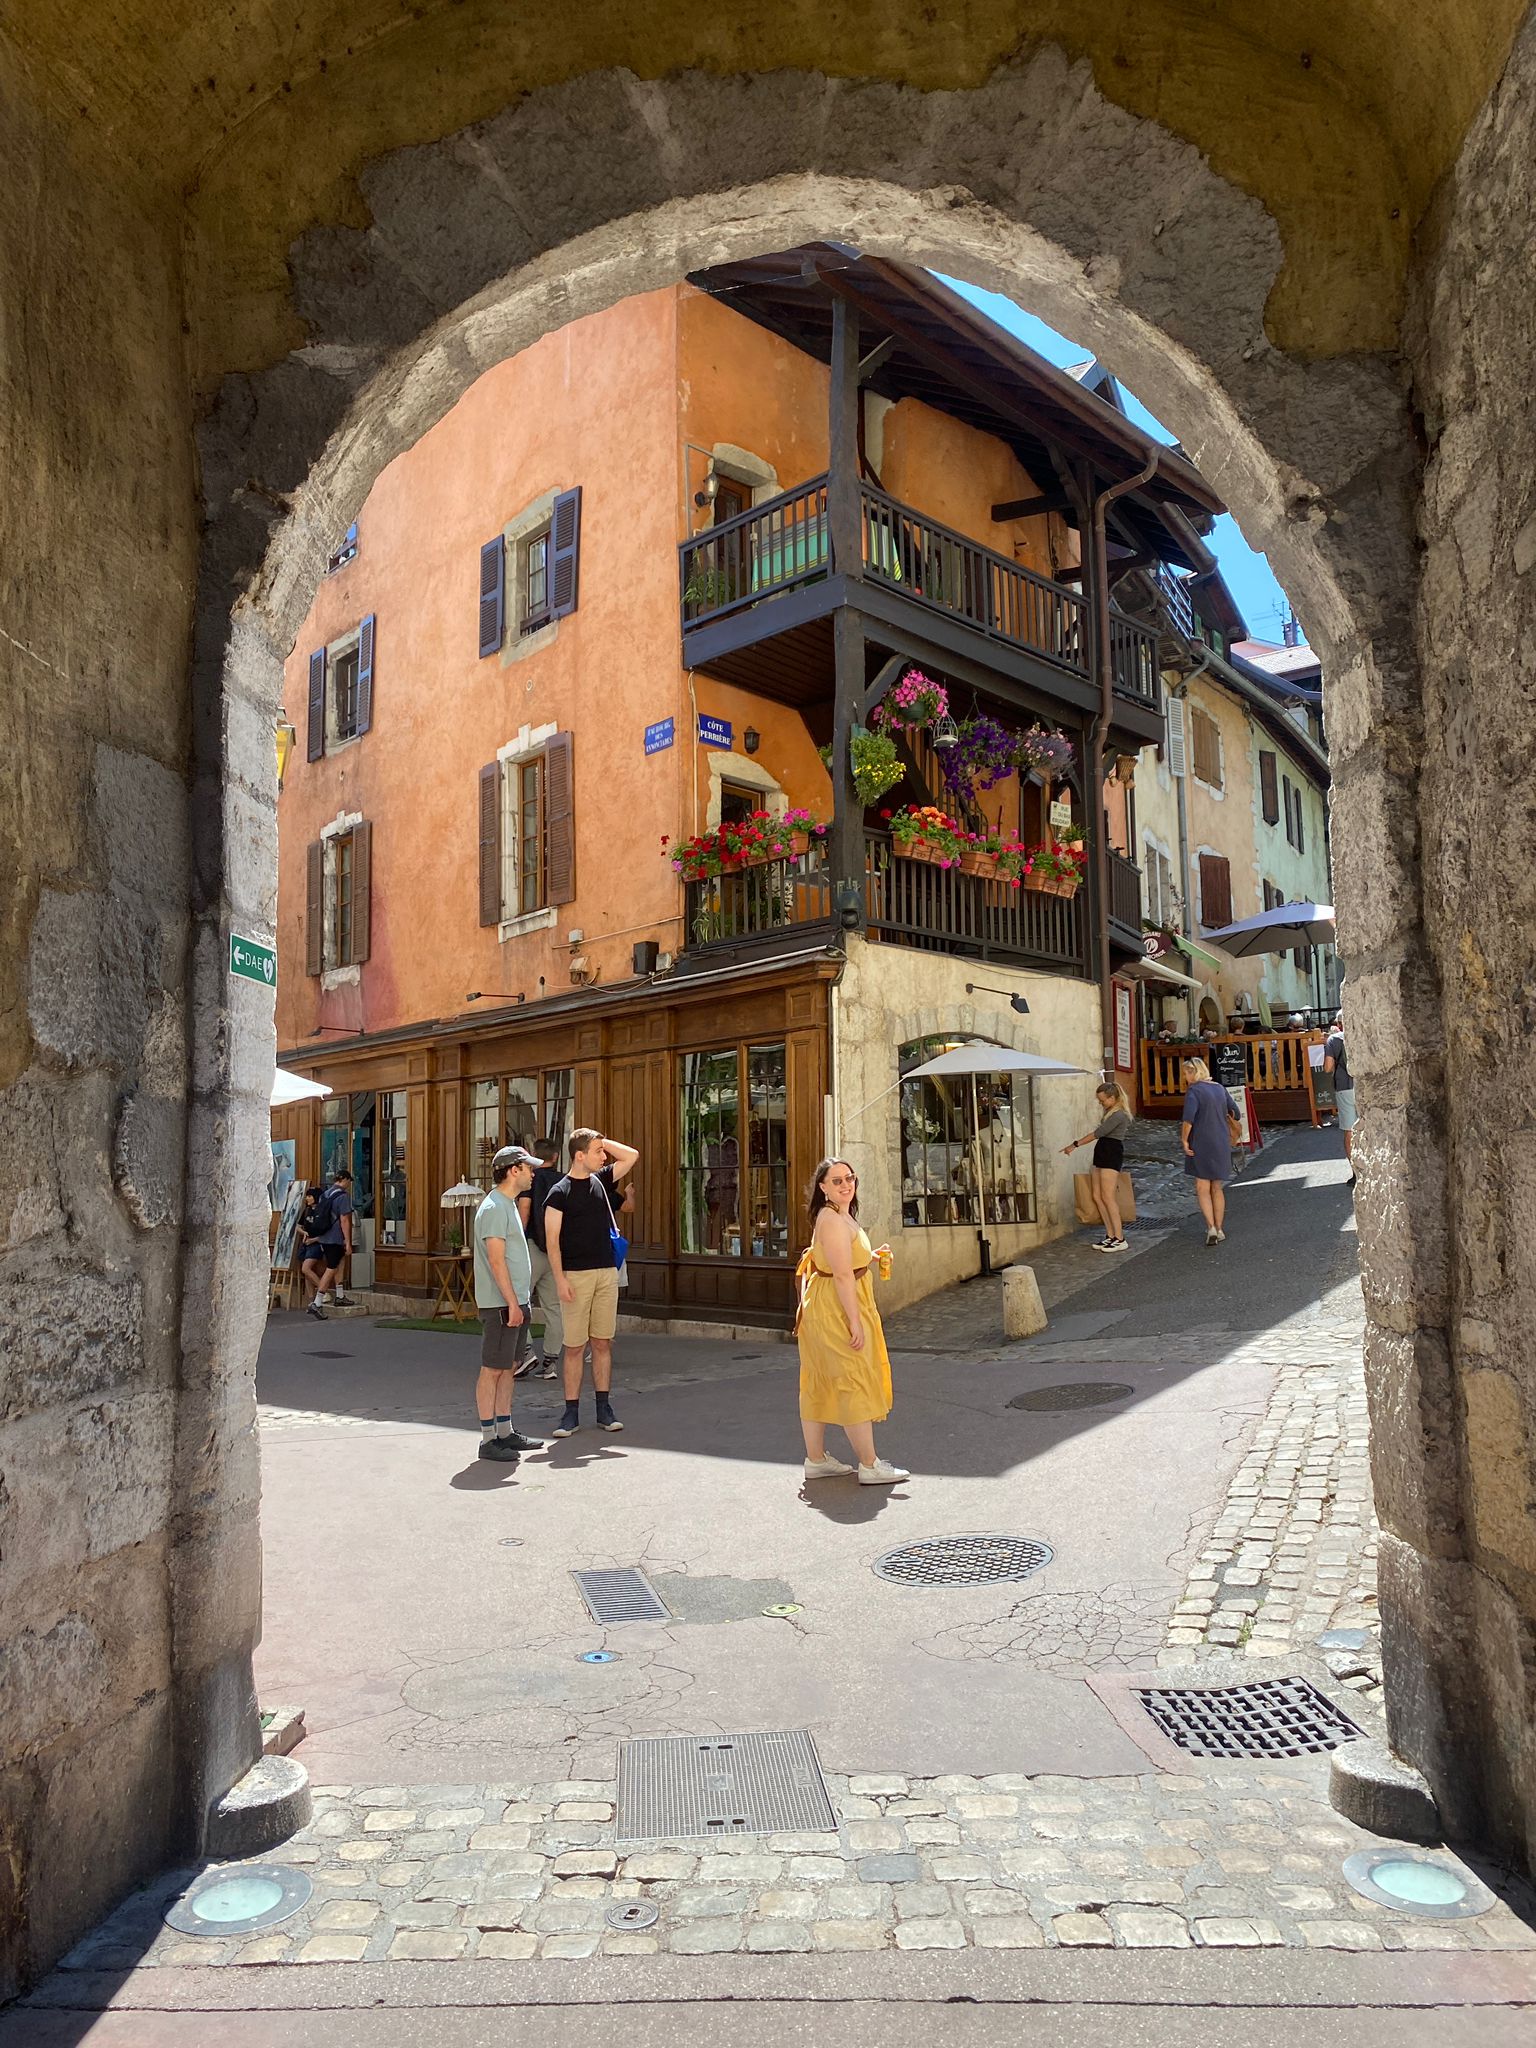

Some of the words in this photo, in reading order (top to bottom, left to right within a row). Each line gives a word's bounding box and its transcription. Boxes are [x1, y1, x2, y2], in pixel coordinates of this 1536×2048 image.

[707, 720, 724, 732] CÔTE
[700, 729, 731, 745] PERRIÈRE
[245, 952, 262, 971] DAE
